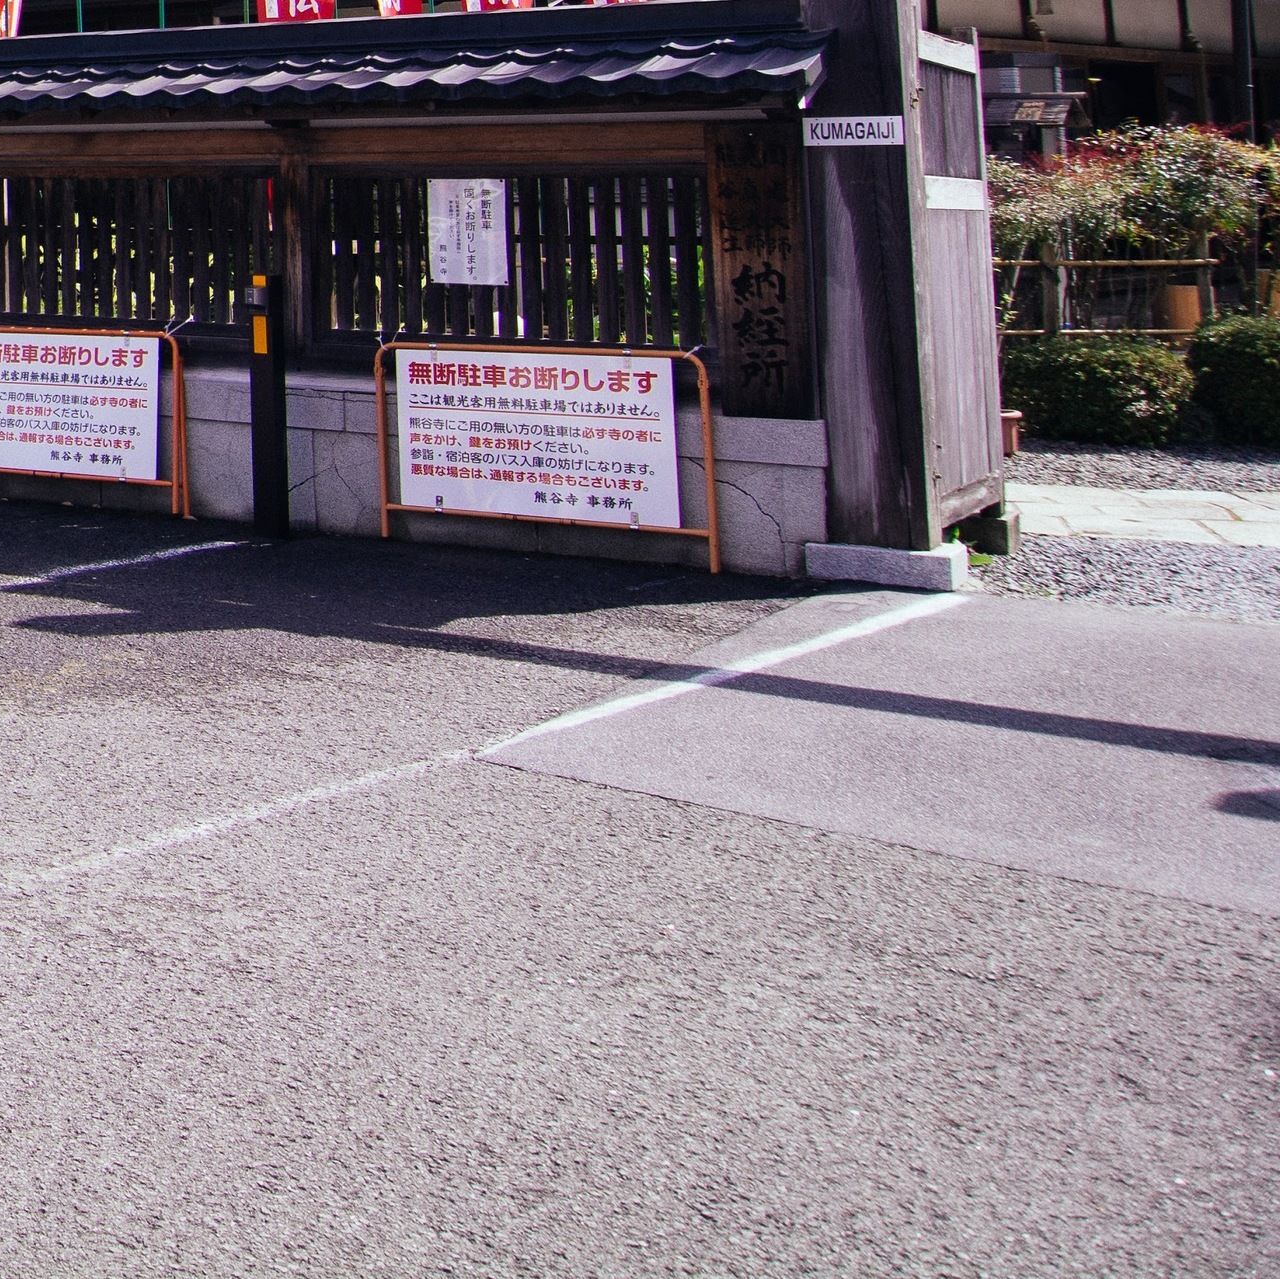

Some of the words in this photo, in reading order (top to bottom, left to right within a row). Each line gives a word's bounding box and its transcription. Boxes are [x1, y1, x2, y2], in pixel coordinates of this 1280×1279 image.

[810, 122, 896, 141] KUMAGAIJI
[480, 189, 492, 230] 無断駐車
[464, 188, 478, 280] 固くお断りします。
[408, 361, 659, 394] 無断駐車お断りします
[409, 393, 660, 418] ここは観光客用無料駐車場ではありません。
[409, 432, 591, 455] 声をかけ、鍵をお預けください。
[50, 450, 83, 463] 熊谷寺
[89, 453, 124, 466] 事務所
[410, 448, 656, 476] 参詣・宿泊客のバス入庫の妨げになります。
[410, 463, 650, 493] 悪質な場合は、通報する場合もございます。
[534, 491, 579, 507] 熊谷寺
[587, 496, 634, 511] 事務所
